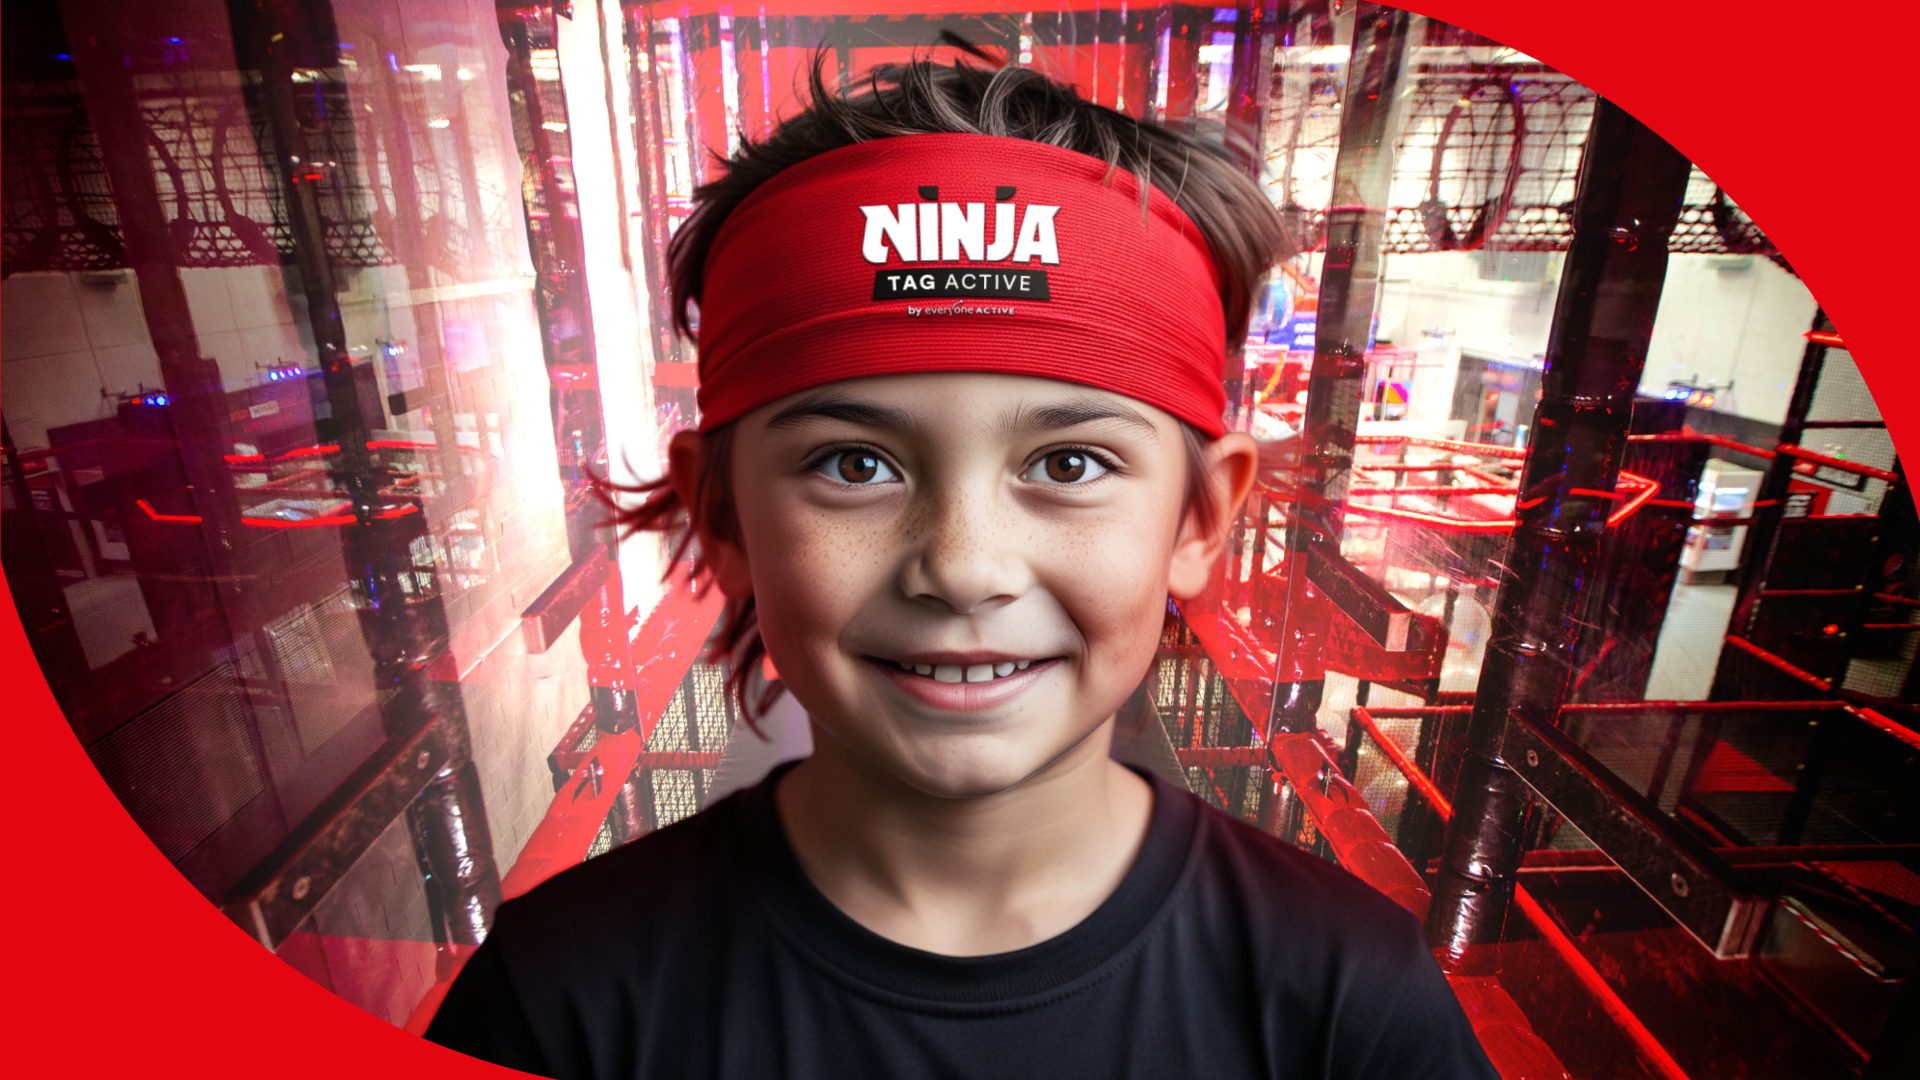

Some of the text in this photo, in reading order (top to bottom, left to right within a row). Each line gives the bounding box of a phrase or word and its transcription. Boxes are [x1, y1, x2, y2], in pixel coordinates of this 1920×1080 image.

[859, 200, 1062, 265] NINJA
[887, 273, 1032, 291] TAG ACTIVE
[908, 301, 1016, 317] by everyone ACTIVE
